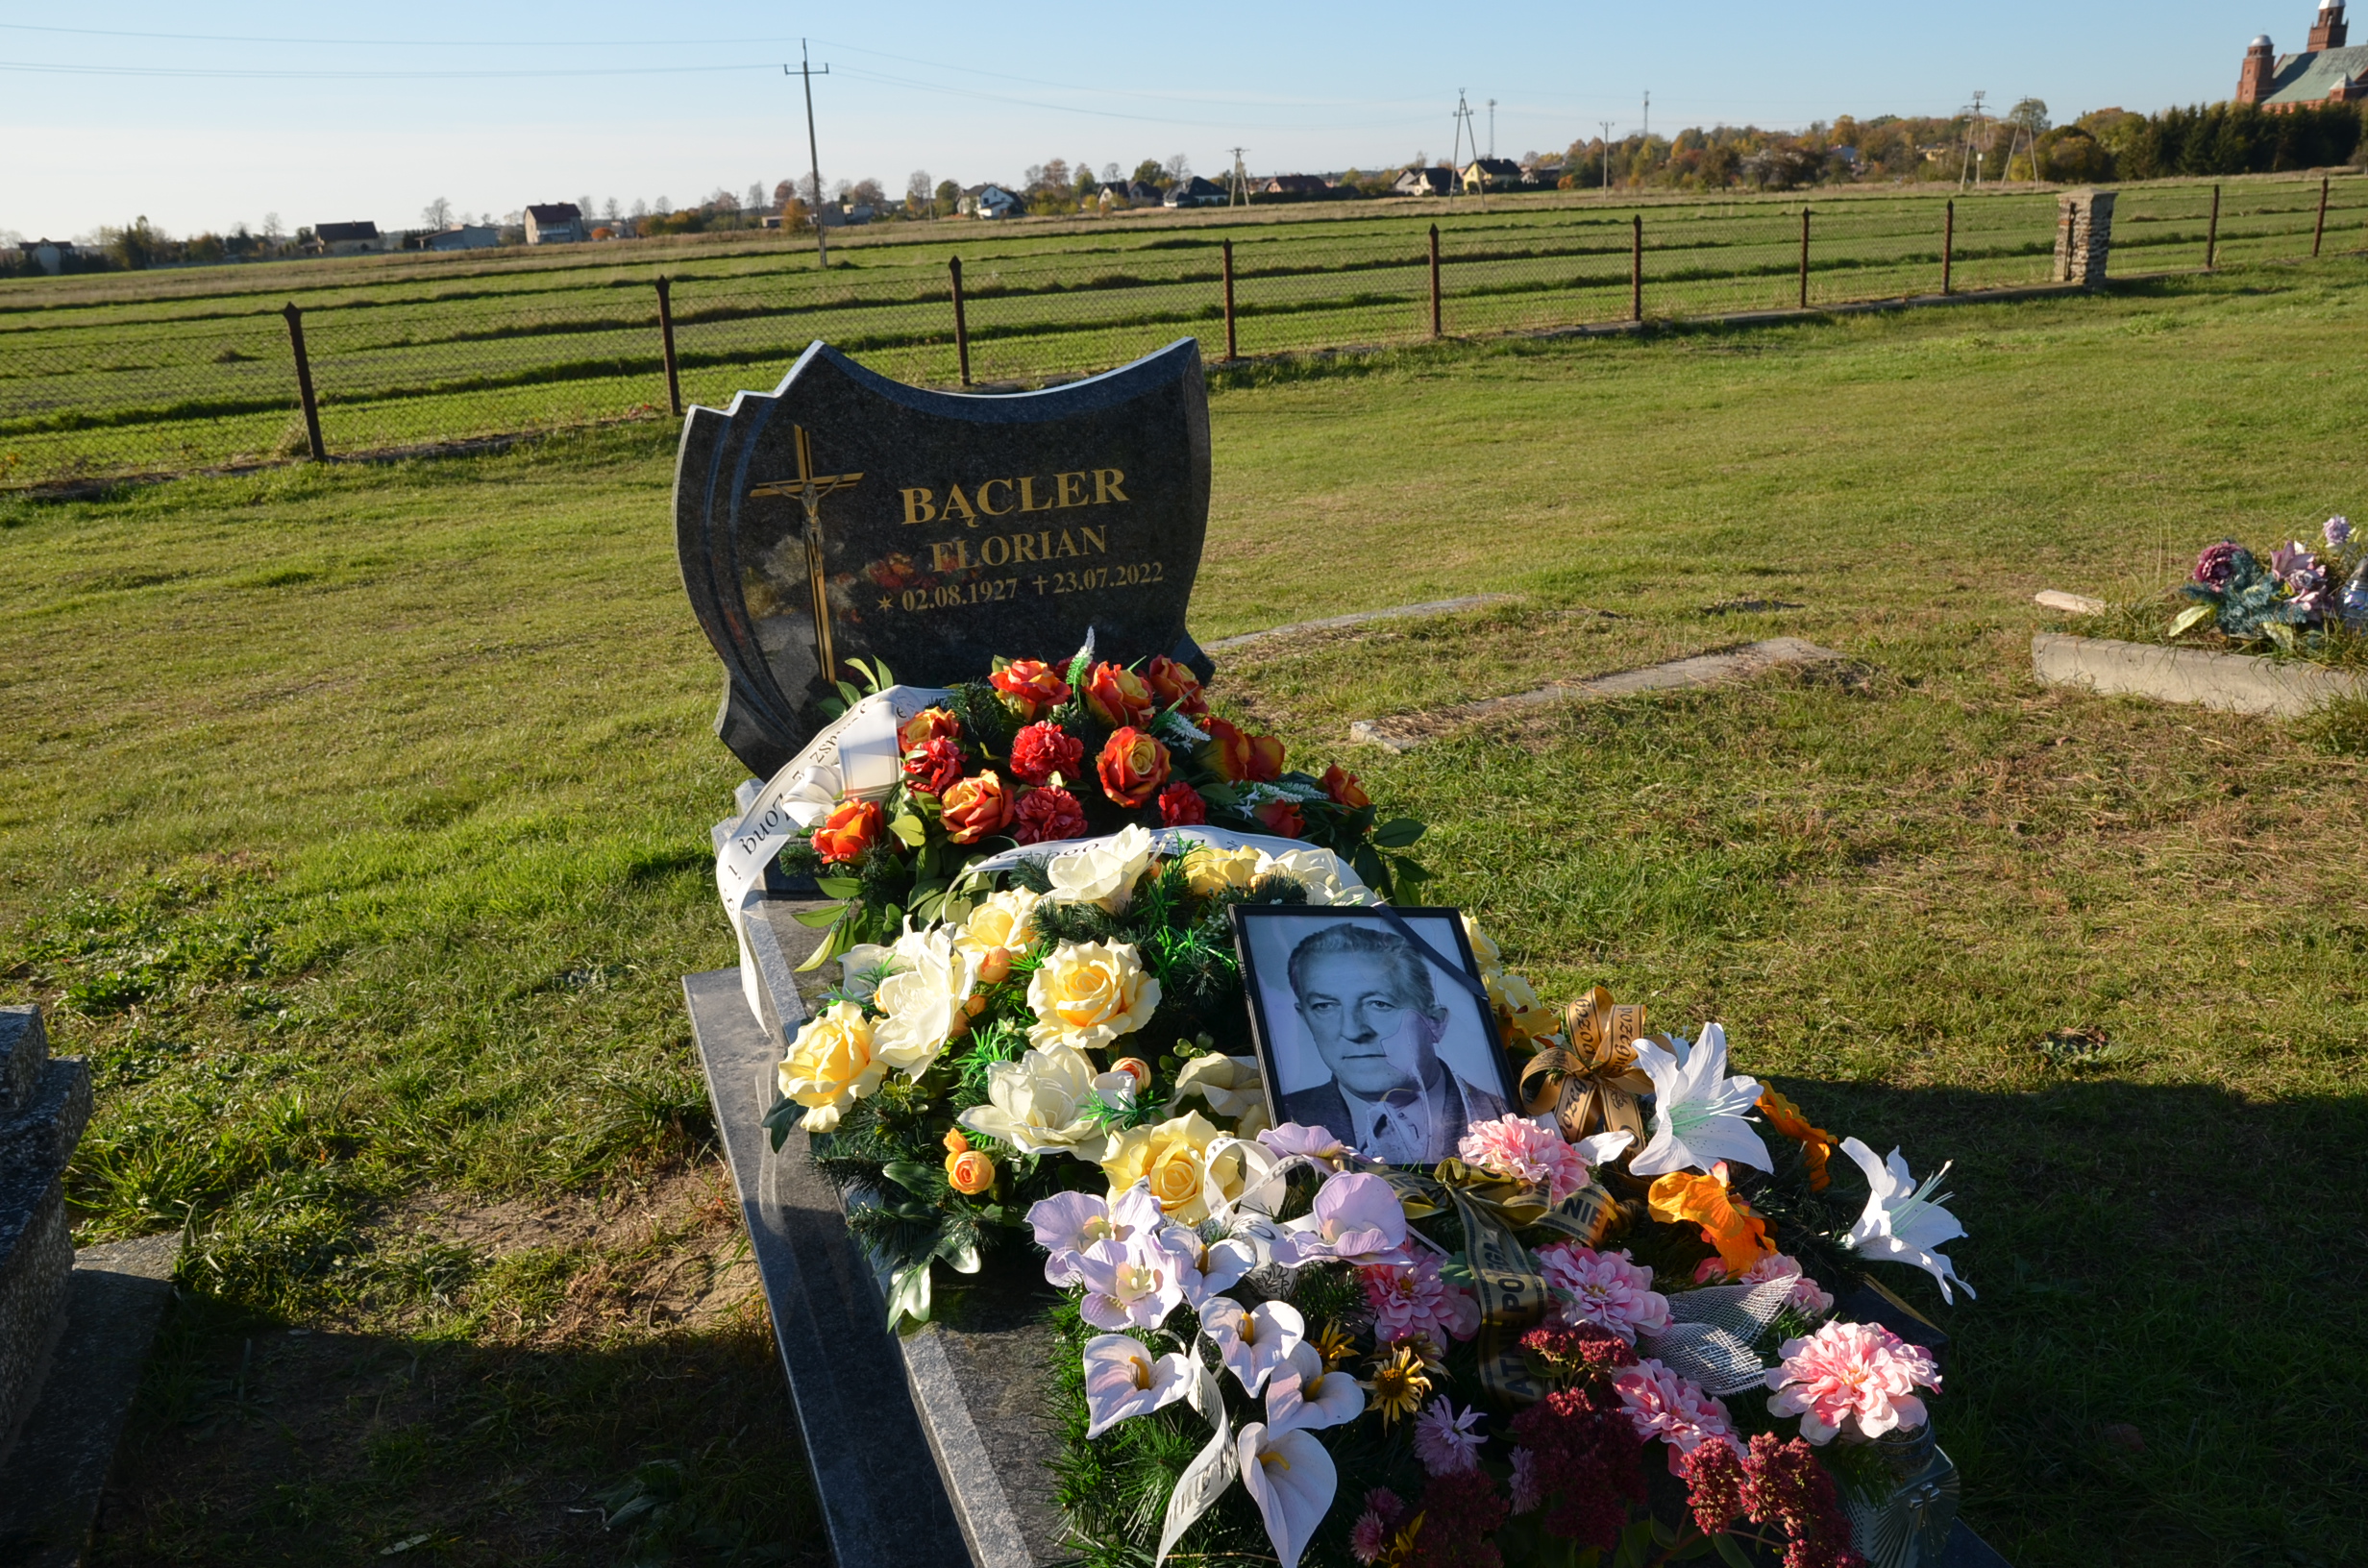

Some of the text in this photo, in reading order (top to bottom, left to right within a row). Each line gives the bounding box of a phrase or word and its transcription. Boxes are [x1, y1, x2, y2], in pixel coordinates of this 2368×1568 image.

[899, 468, 1129, 527] BĄCLER
[929, 525, 1107, 573] FLORIAN
[901, 561, 1164, 612] 02.08.1927 23.07.2022
